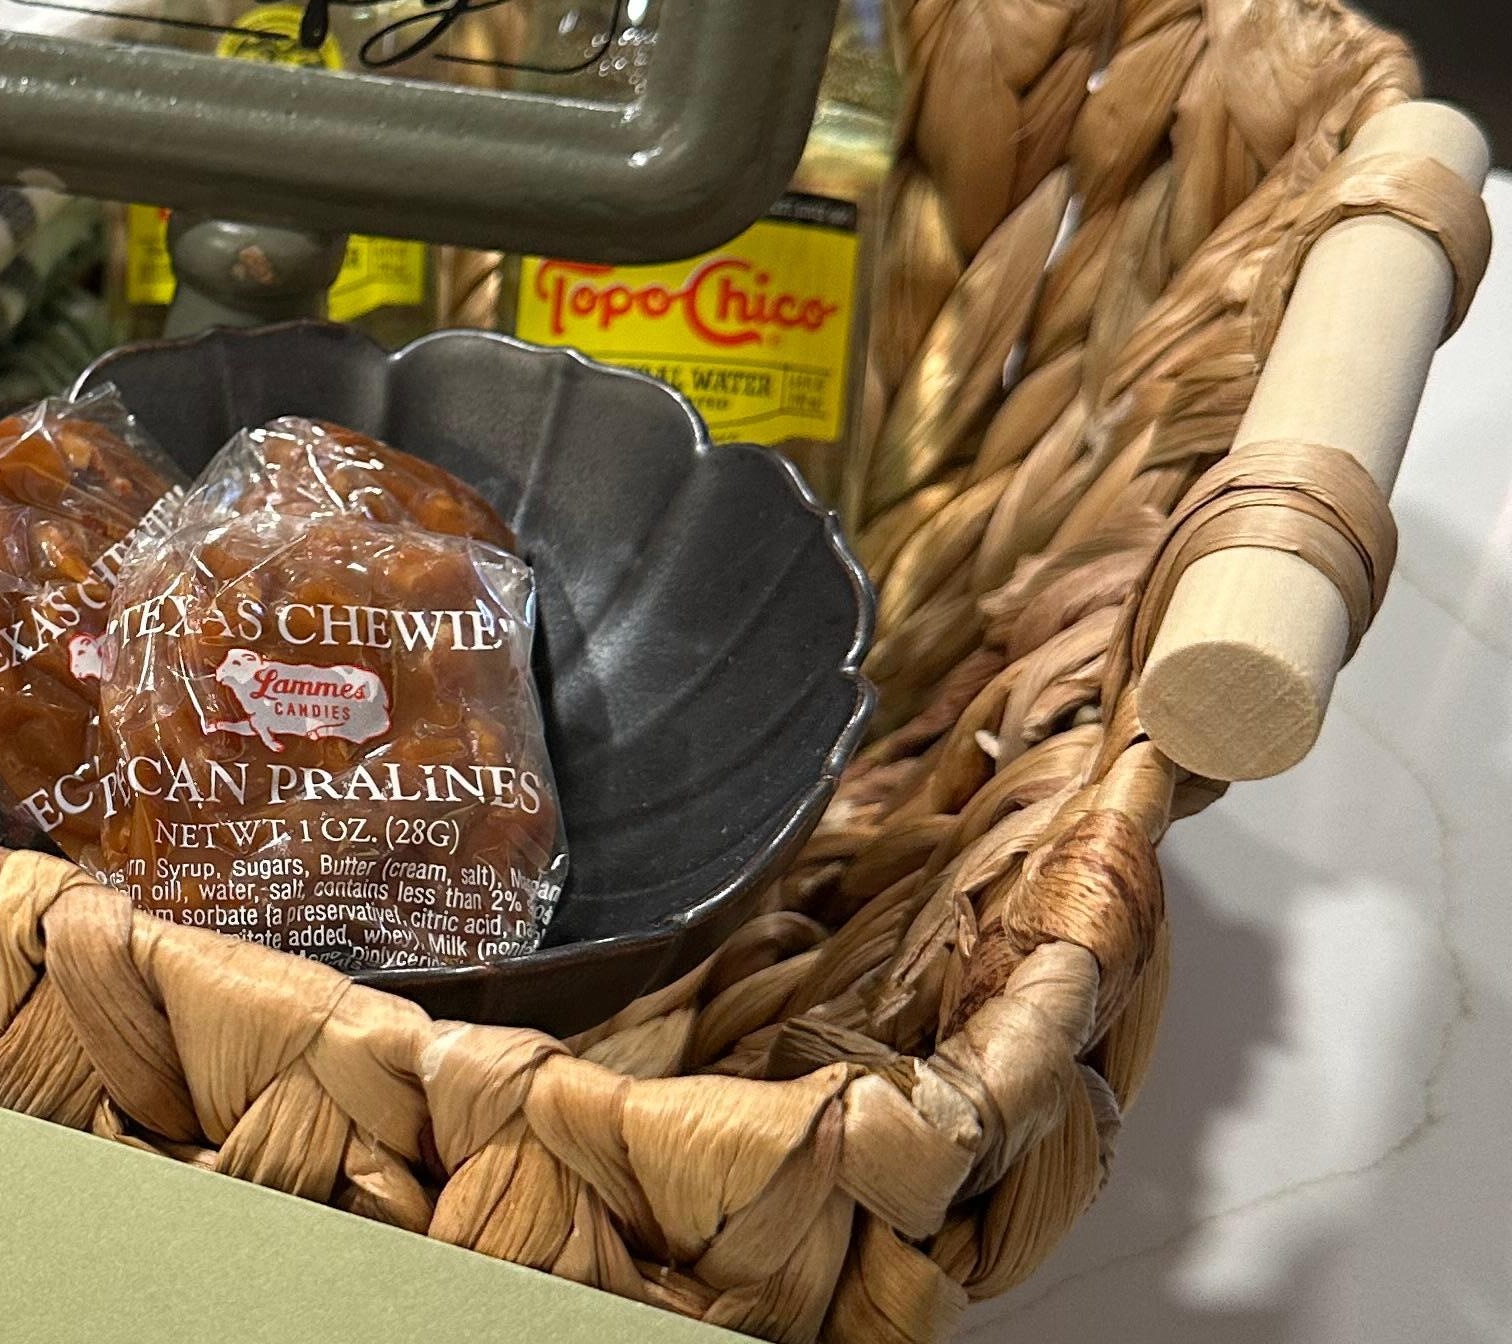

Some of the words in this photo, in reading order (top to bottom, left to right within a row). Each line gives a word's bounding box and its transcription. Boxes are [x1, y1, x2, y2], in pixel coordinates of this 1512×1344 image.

[535, 258, 685, 337] Topo
[685, 257, 838, 348] Chico
[691, 367, 772, 399] WATER
[250, 667, 368, 701] Lammes
[274, 701, 351, 721] CANDIES
[266, 762, 543, 815] PRALINES
[154, 818, 220, 849] NET
[300, 819, 312, 843] 1
[321, 817, 377, 844] OZ.
[385, 815, 460, 855] (28G)
[156, 856, 221, 881] Syrup,
[320, 854, 377, 877] Butter
[382, 857, 453, 886] (cream,
[461, 864, 502, 892] salt),
[199, 879, 259, 903] water,
[313, 877, 389, 901] contains
[397, 880, 436, 906] less
[445, 888, 483, 911] than
[490, 890, 523, 913] 2%
[181, 903, 259, 927] sorbate
[410, 909, 465, 932] citric
[464, 913, 508, 938] acid,
[288, 924, 353, 948] added,
[427, 933, 468, 958] Milk
